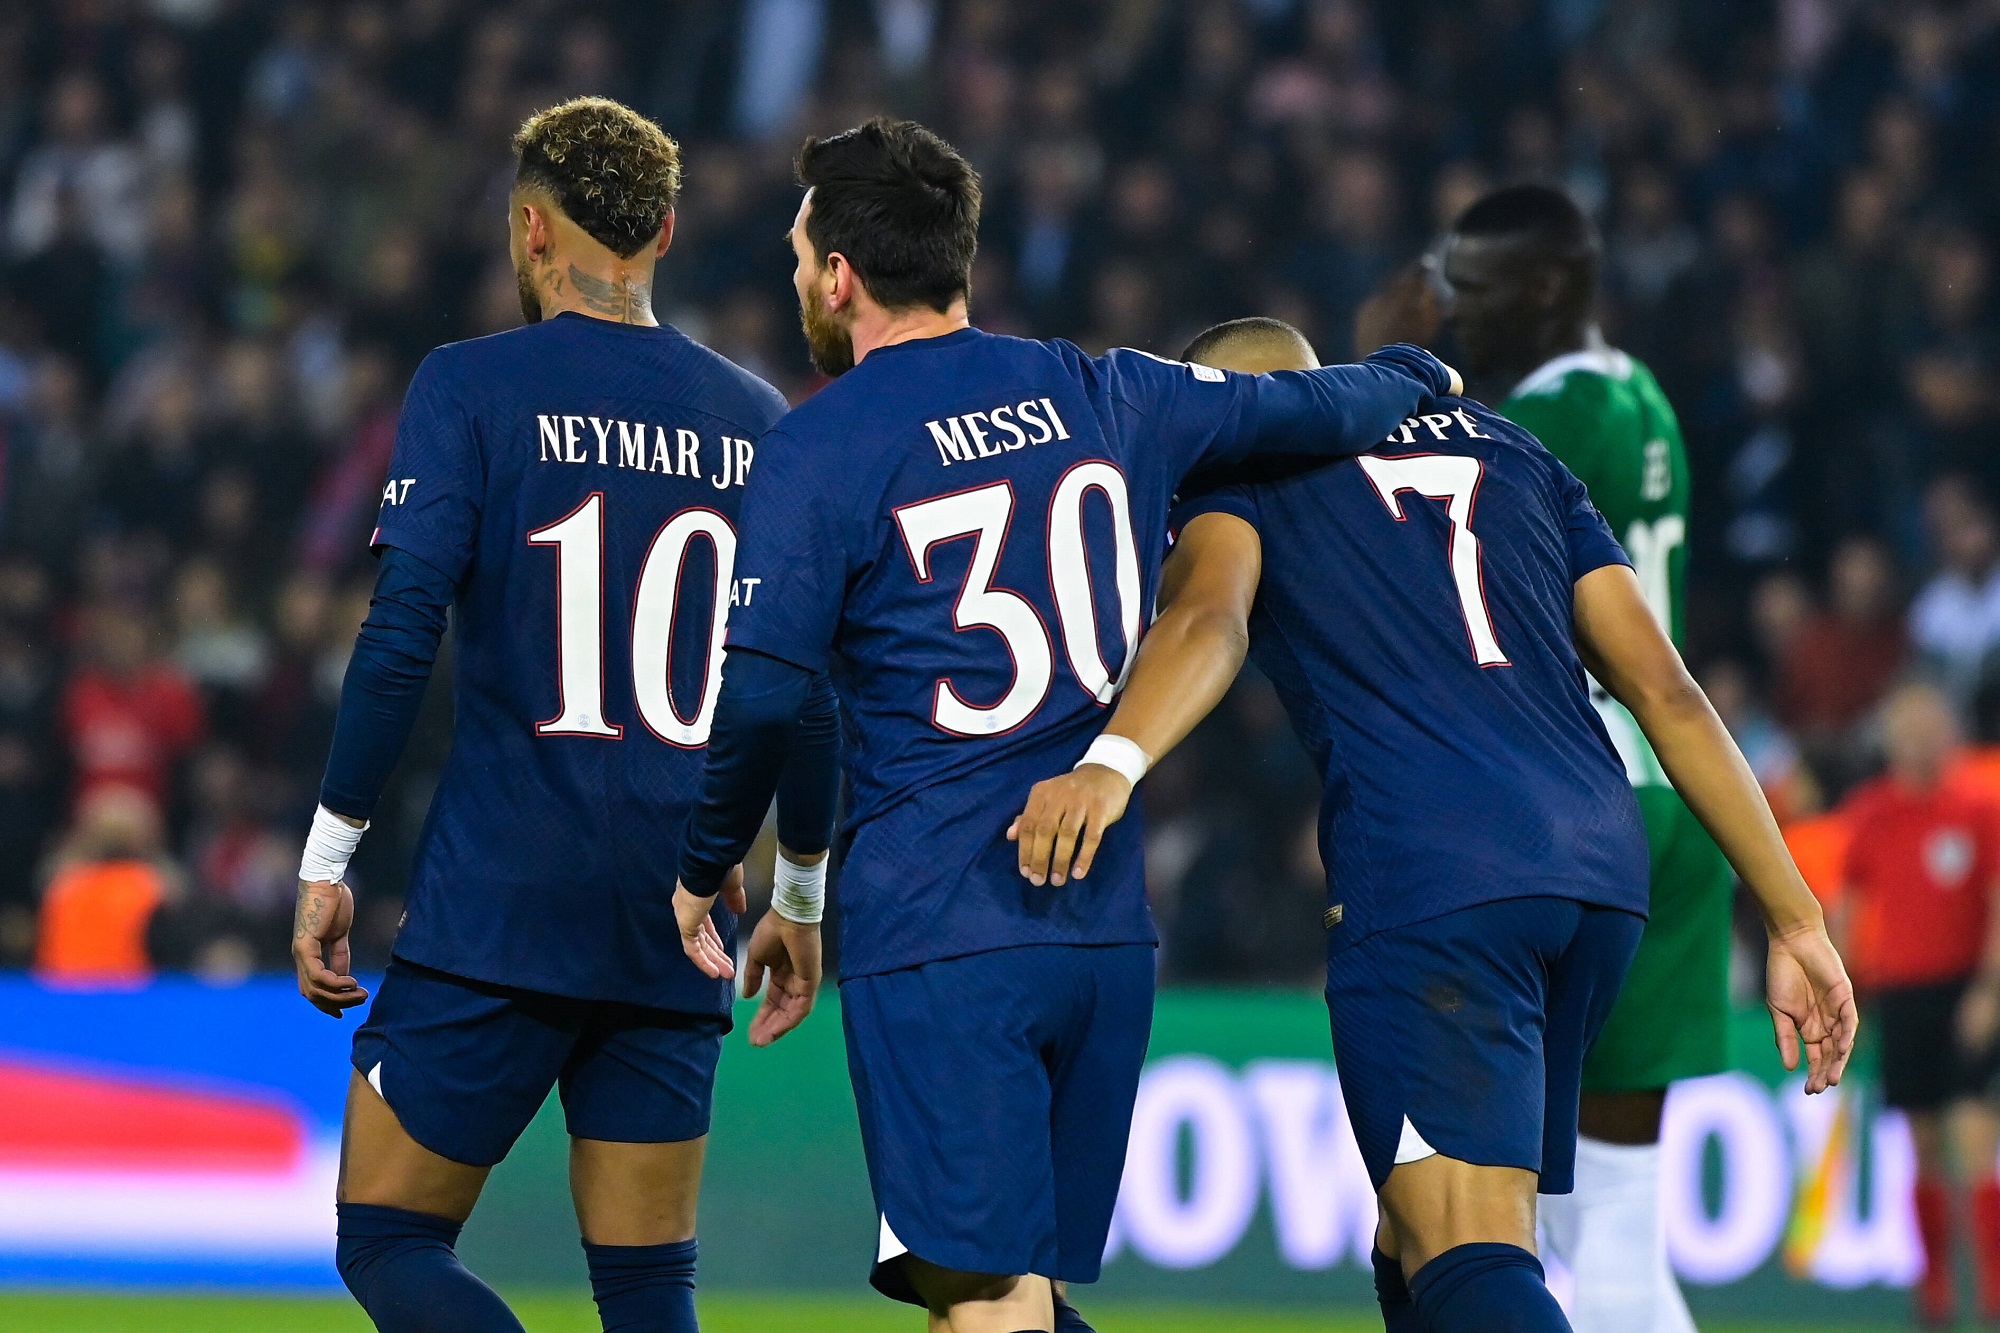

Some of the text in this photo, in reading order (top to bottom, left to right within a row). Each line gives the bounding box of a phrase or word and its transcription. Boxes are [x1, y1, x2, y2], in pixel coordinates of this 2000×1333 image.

[537, 415, 754, 489] NEYMAR JR
[925, 398, 1070, 466] MESSI
[1386, 406, 1492, 444] PPÉ
[381, 478, 417, 509] AT
[1355, 452, 1512, 668] 7
[526, 491, 738, 750] 10
[892, 459, 1143, 738] 30
